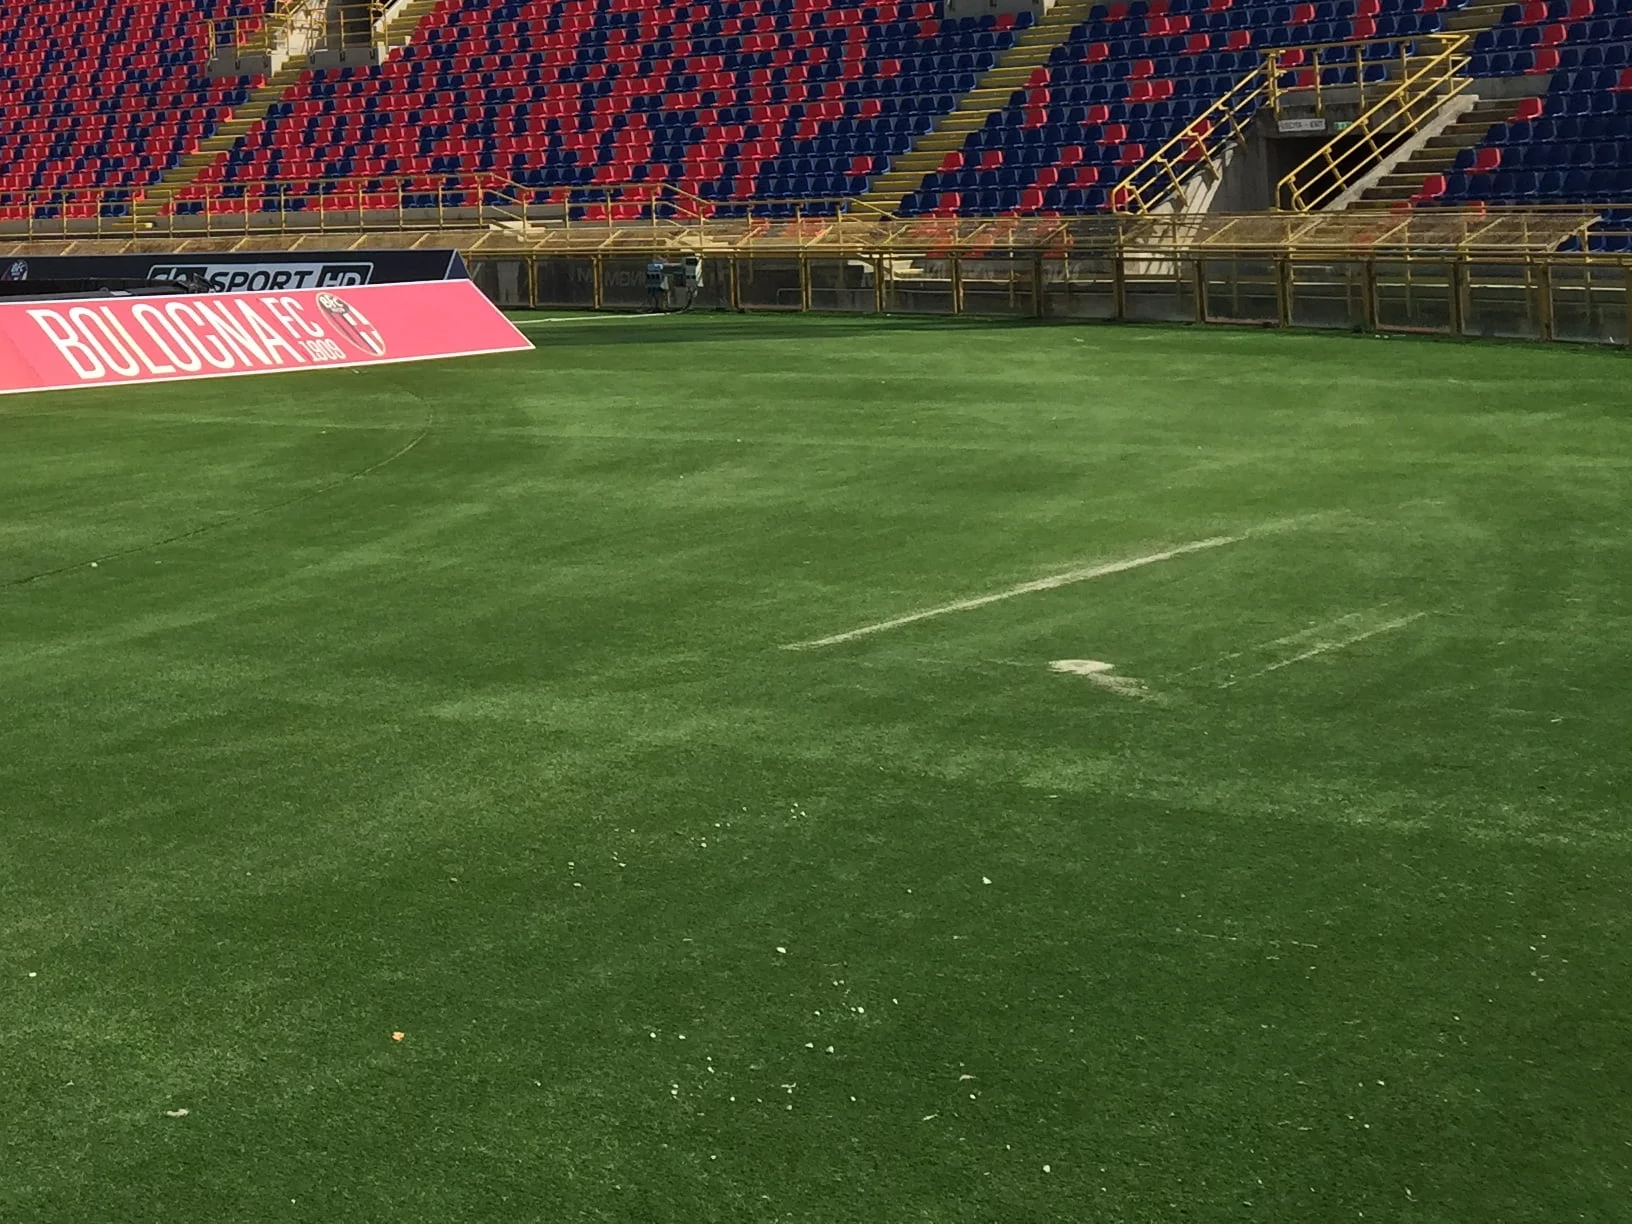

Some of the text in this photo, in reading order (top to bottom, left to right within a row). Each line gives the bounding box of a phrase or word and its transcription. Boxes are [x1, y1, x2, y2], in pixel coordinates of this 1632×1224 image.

[207, 270, 313, 293] SPORT
[26, 296, 325, 380] BOLOGNA FC
